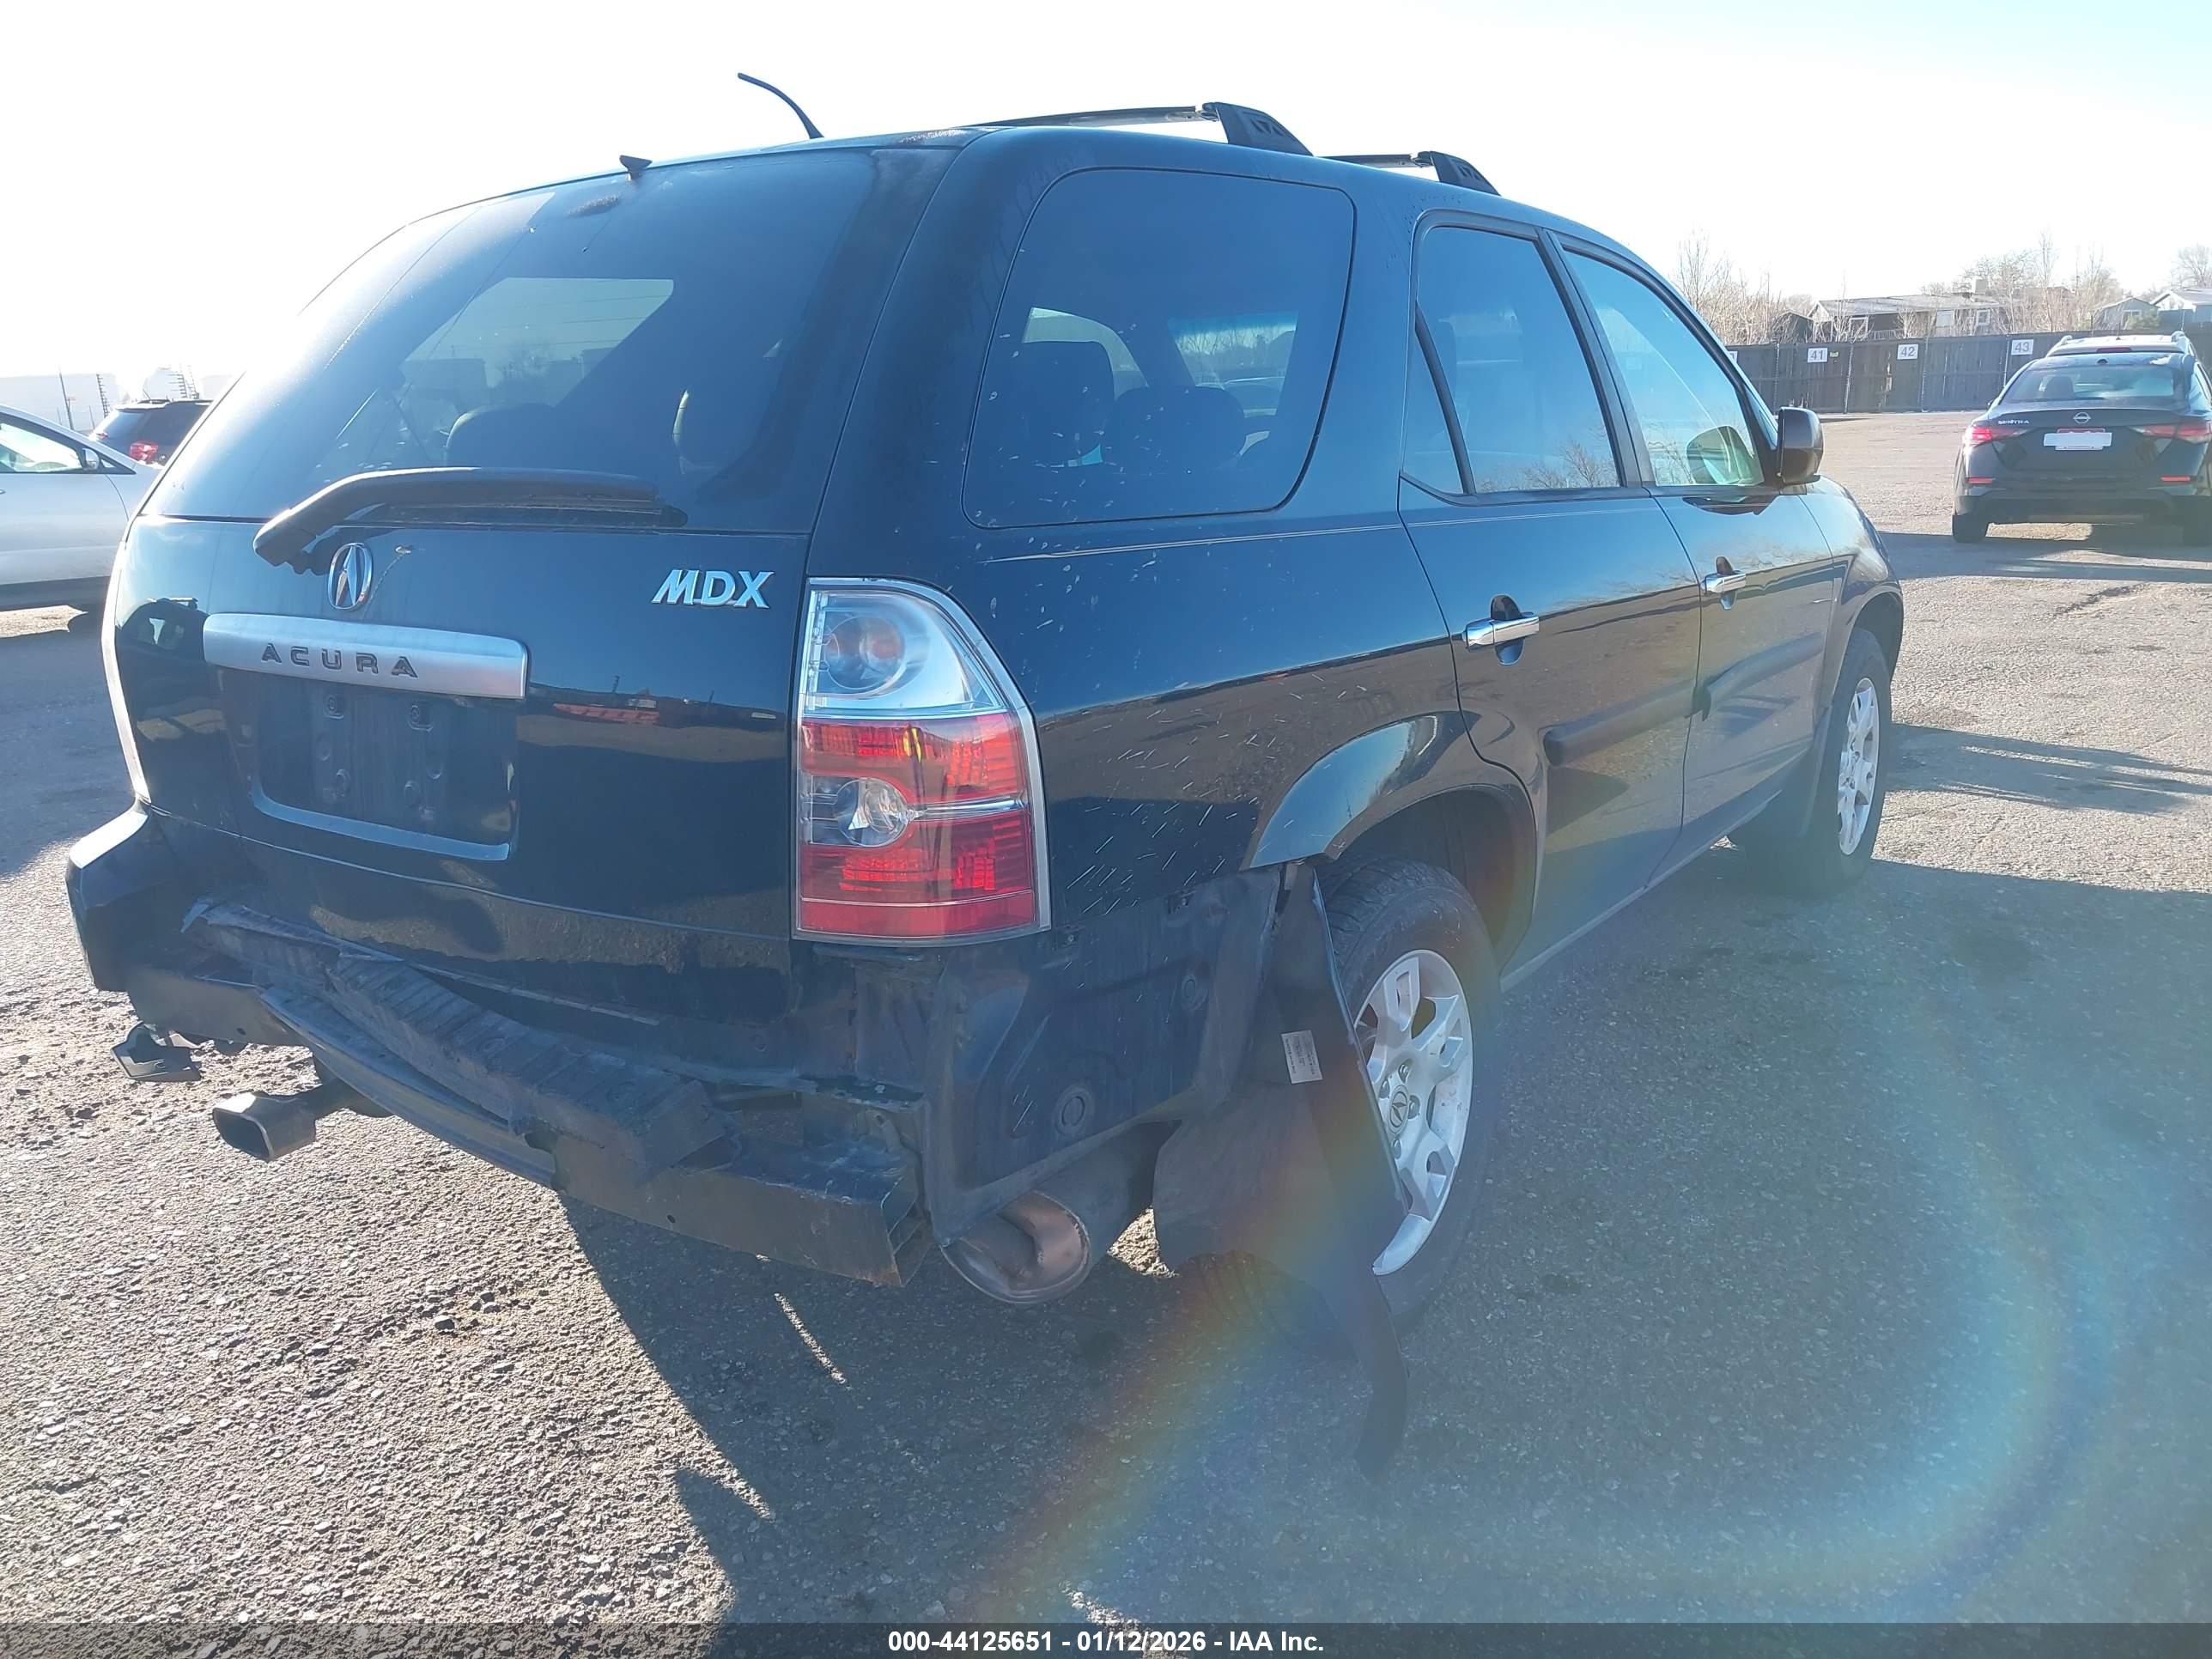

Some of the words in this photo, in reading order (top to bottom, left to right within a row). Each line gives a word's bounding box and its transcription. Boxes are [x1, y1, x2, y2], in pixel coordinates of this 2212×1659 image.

[1899, 346, 1916, 357] 42
[2014, 341, 2030, 353] 43
[1809, 349, 1824, 361] 41
[651, 569, 775, 609] MDX
[261, 642, 419, 678] ACURA
